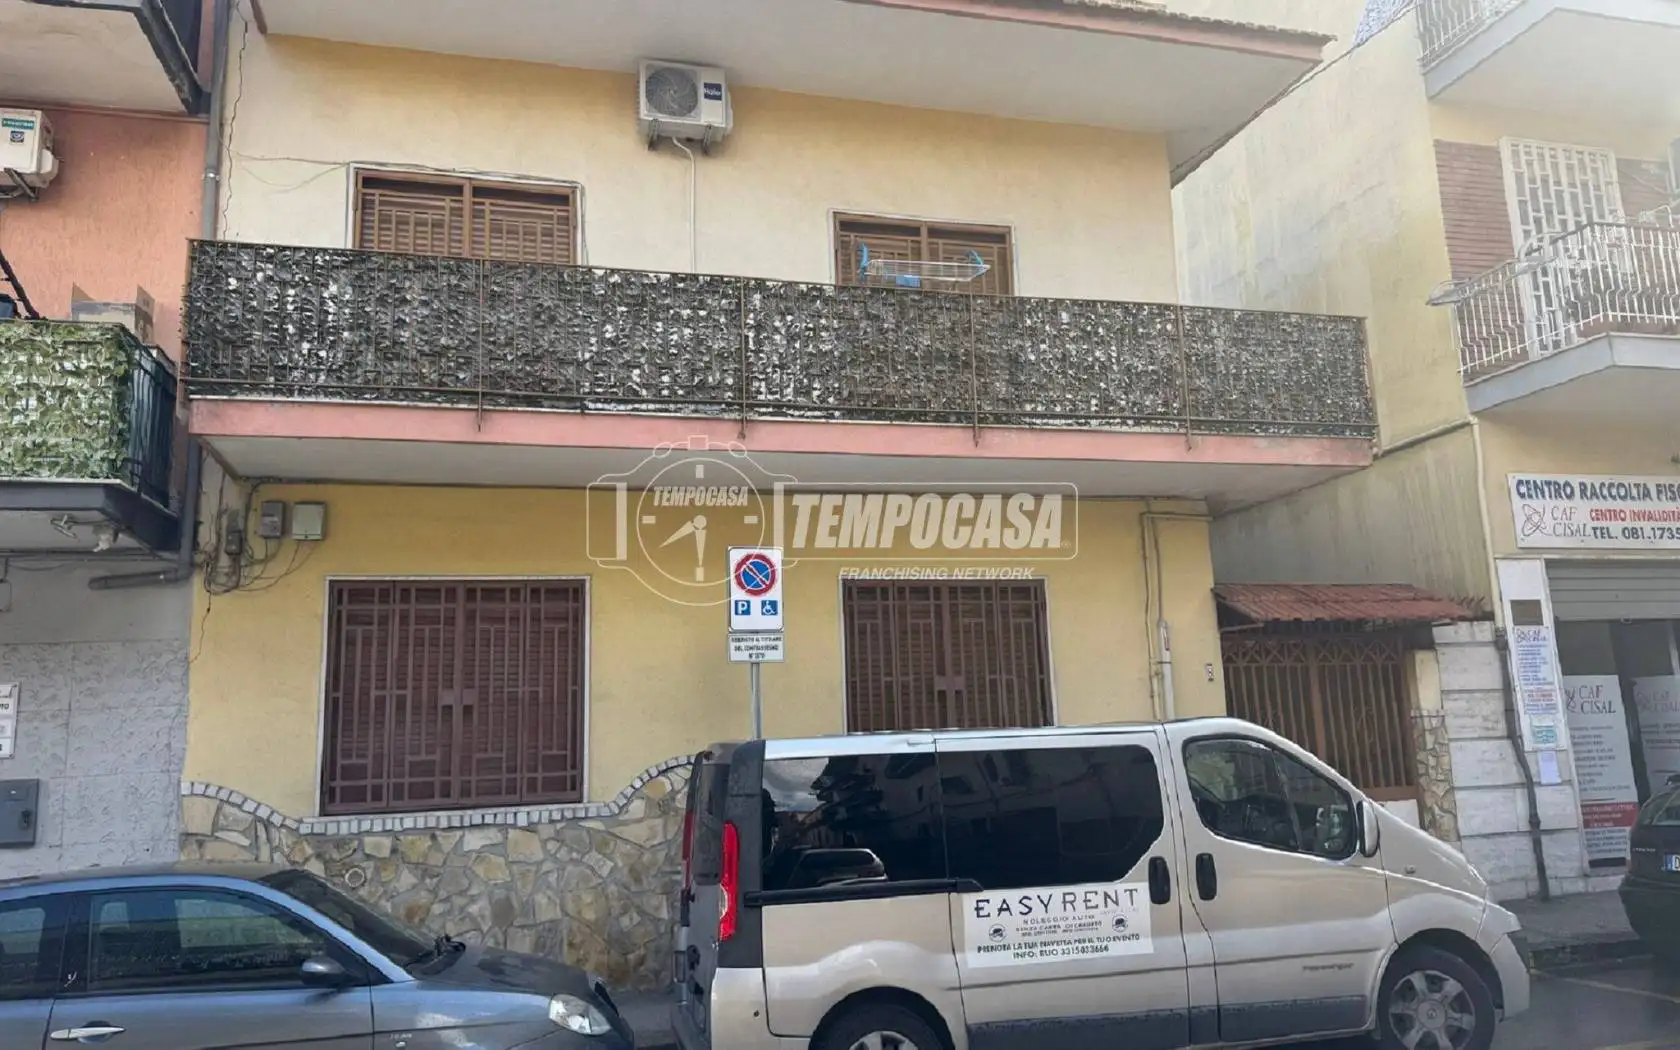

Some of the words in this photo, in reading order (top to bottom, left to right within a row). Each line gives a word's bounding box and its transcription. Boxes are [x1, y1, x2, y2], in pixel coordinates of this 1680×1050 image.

[1516, 479, 1575, 501] CENTRO
[1579, 482, 1653, 501] RACCOLTA
[1551, 506, 1578, 521] CAF
[1589, 508, 1627, 522] CENTRO
[1552, 522, 1591, 538] CISAL
[1591, 526, 1618, 540] TEL.
[1579, 684, 1604, 700] CAF
[1580, 700, 1616, 715] CISAL
